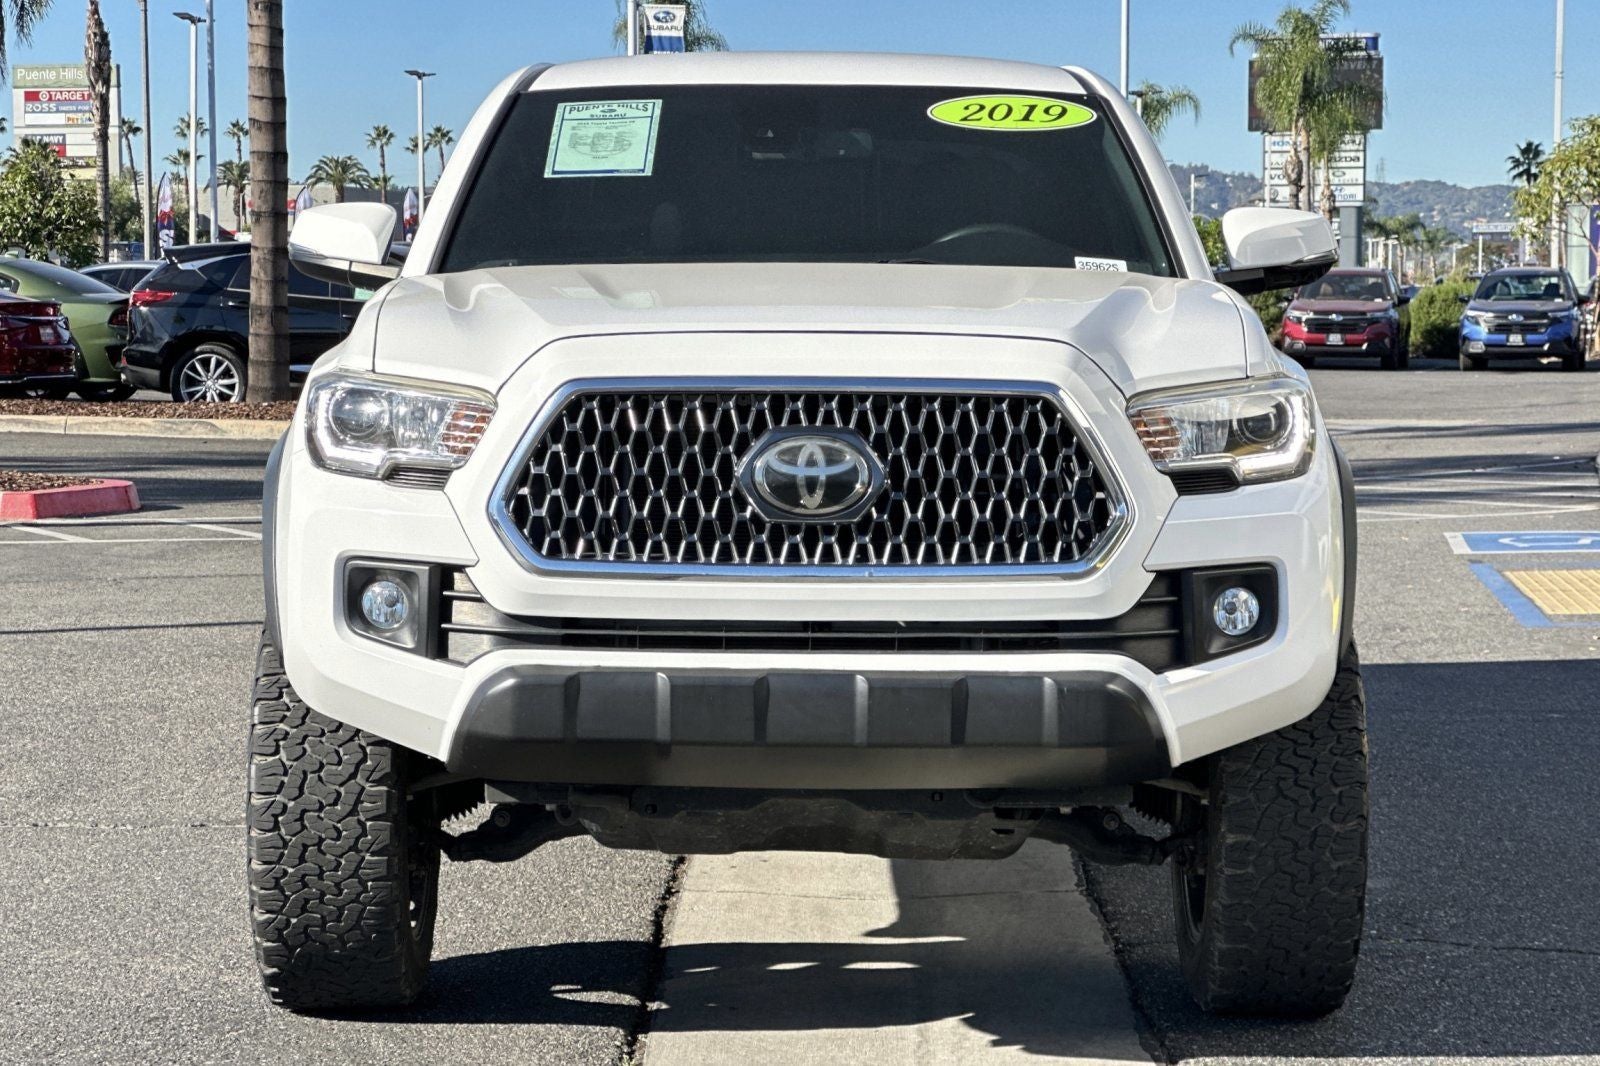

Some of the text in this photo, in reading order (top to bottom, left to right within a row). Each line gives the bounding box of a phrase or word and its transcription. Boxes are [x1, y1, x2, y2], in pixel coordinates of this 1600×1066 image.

[17, 68, 83, 80] Puente Hills
[50, 91, 89, 100] TARGET
[25, 103, 57, 112] ROSS
[569, 103, 649, 114] PUENTE HILLS
[959, 103, 1068, 123] 2019
